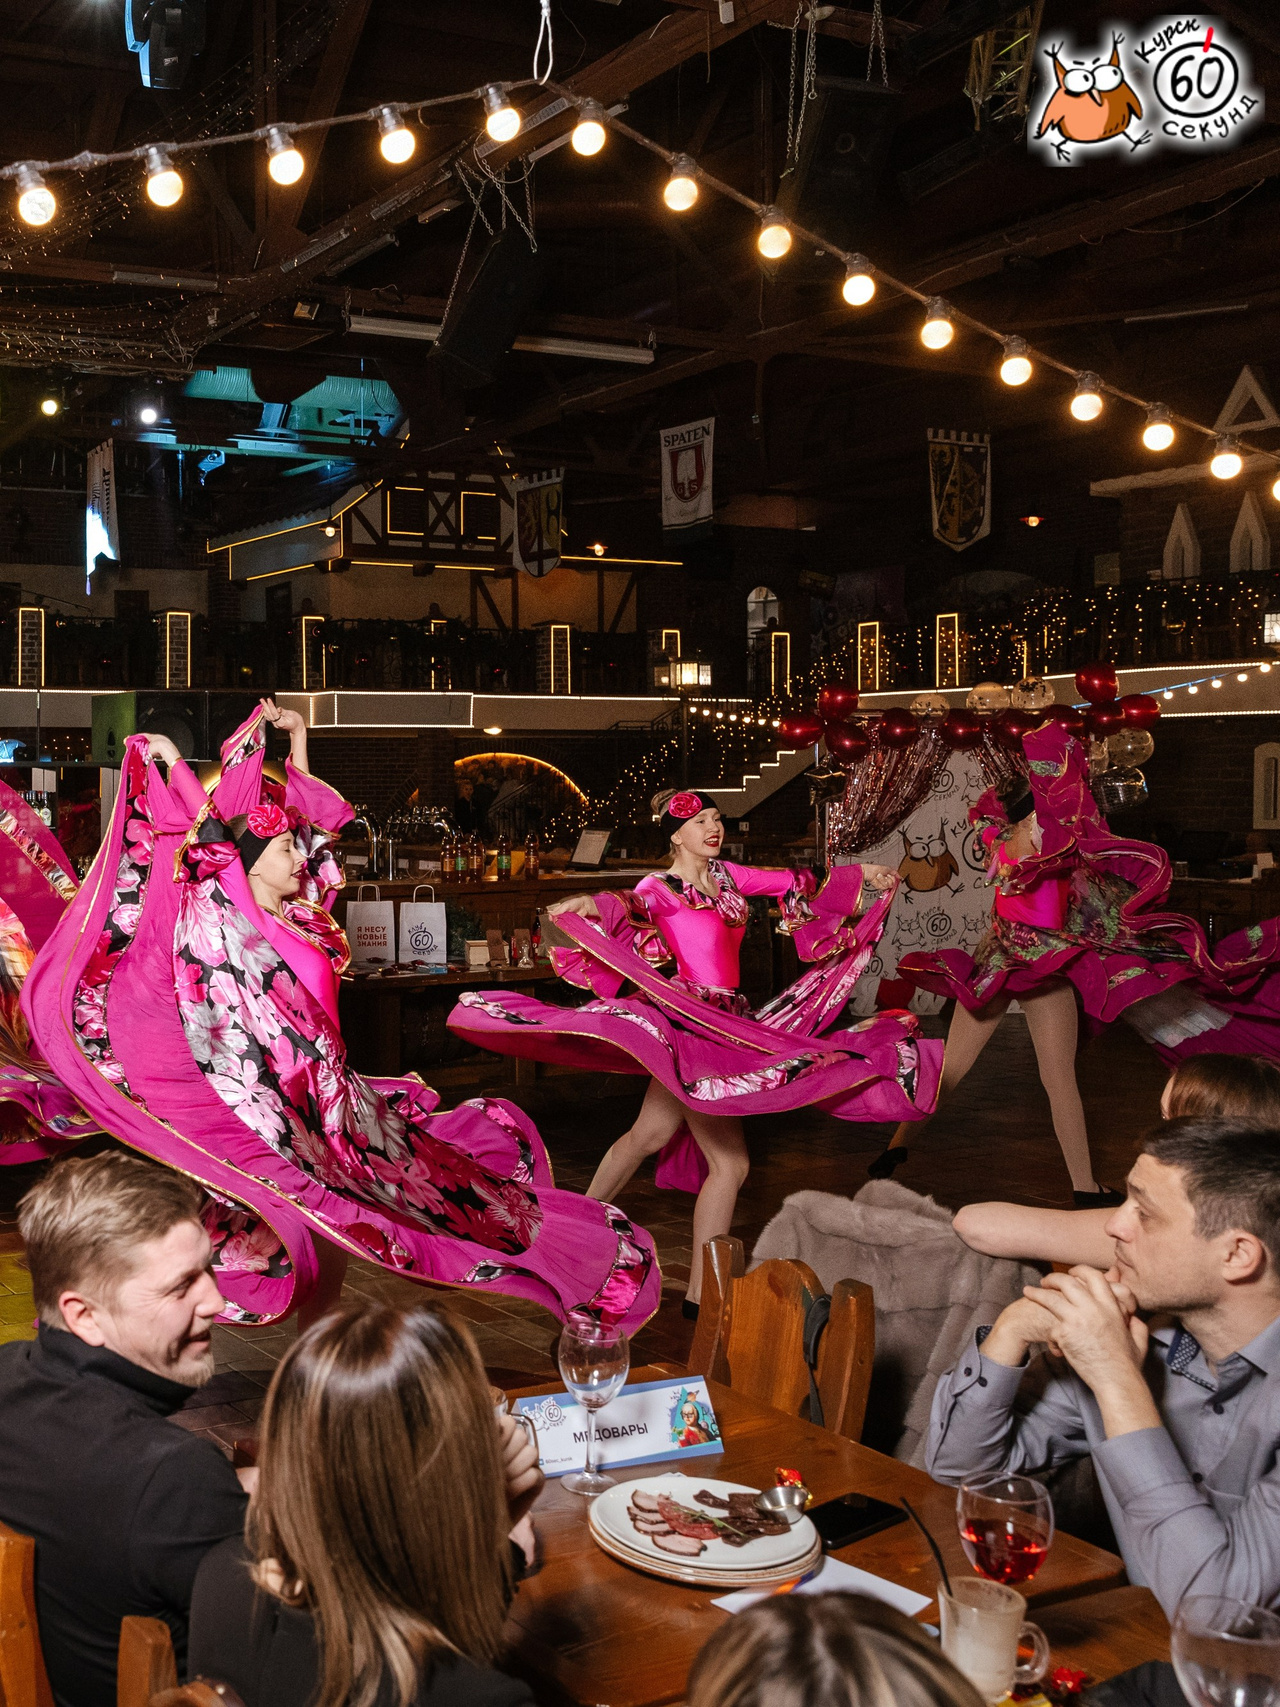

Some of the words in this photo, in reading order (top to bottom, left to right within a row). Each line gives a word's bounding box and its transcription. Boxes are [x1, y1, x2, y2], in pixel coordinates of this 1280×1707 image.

[663, 424, 710, 448] SPATEN
[931, 917, 948, 932] 60
[415, 934, 429, 946] 60
[548, 1407, 559, 1419] 60
